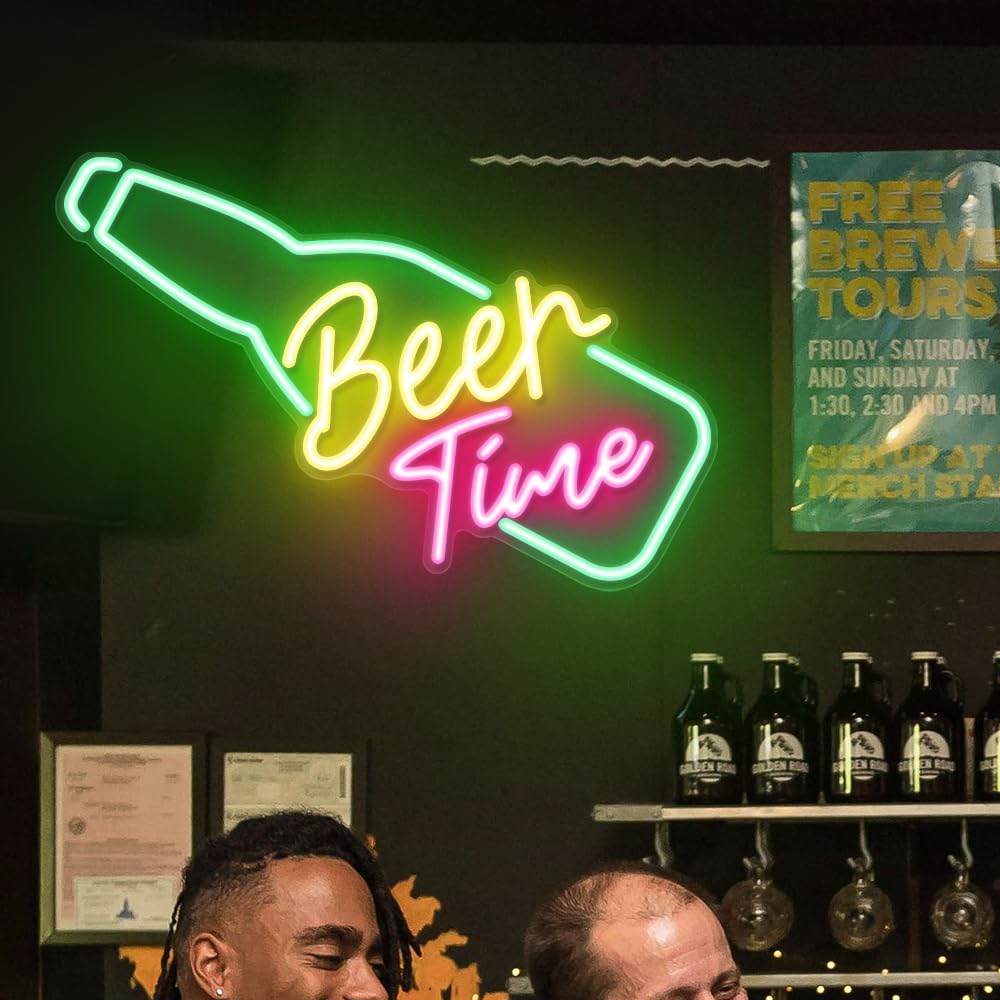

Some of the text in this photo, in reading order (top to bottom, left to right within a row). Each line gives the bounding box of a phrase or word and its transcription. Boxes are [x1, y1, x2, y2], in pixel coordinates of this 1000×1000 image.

[808, 180, 946, 224] FREE
[806, 275, 998, 320] TOURS
[807, 338, 995, 362] FRIDAY, SATURDAY,
[282, 276, 611, 470] Beer
[807, 367, 959, 388] AND SUNDAY AT
[809, 394, 998, 417] 1:30, 2:30 AND 4PM
[807, 444, 889, 470] SIGN
[893, 444, 940, 470] UP
[947, 444, 991, 469] AT
[389, 405, 655, 564] Time
[808, 474, 928, 499] MERCH
